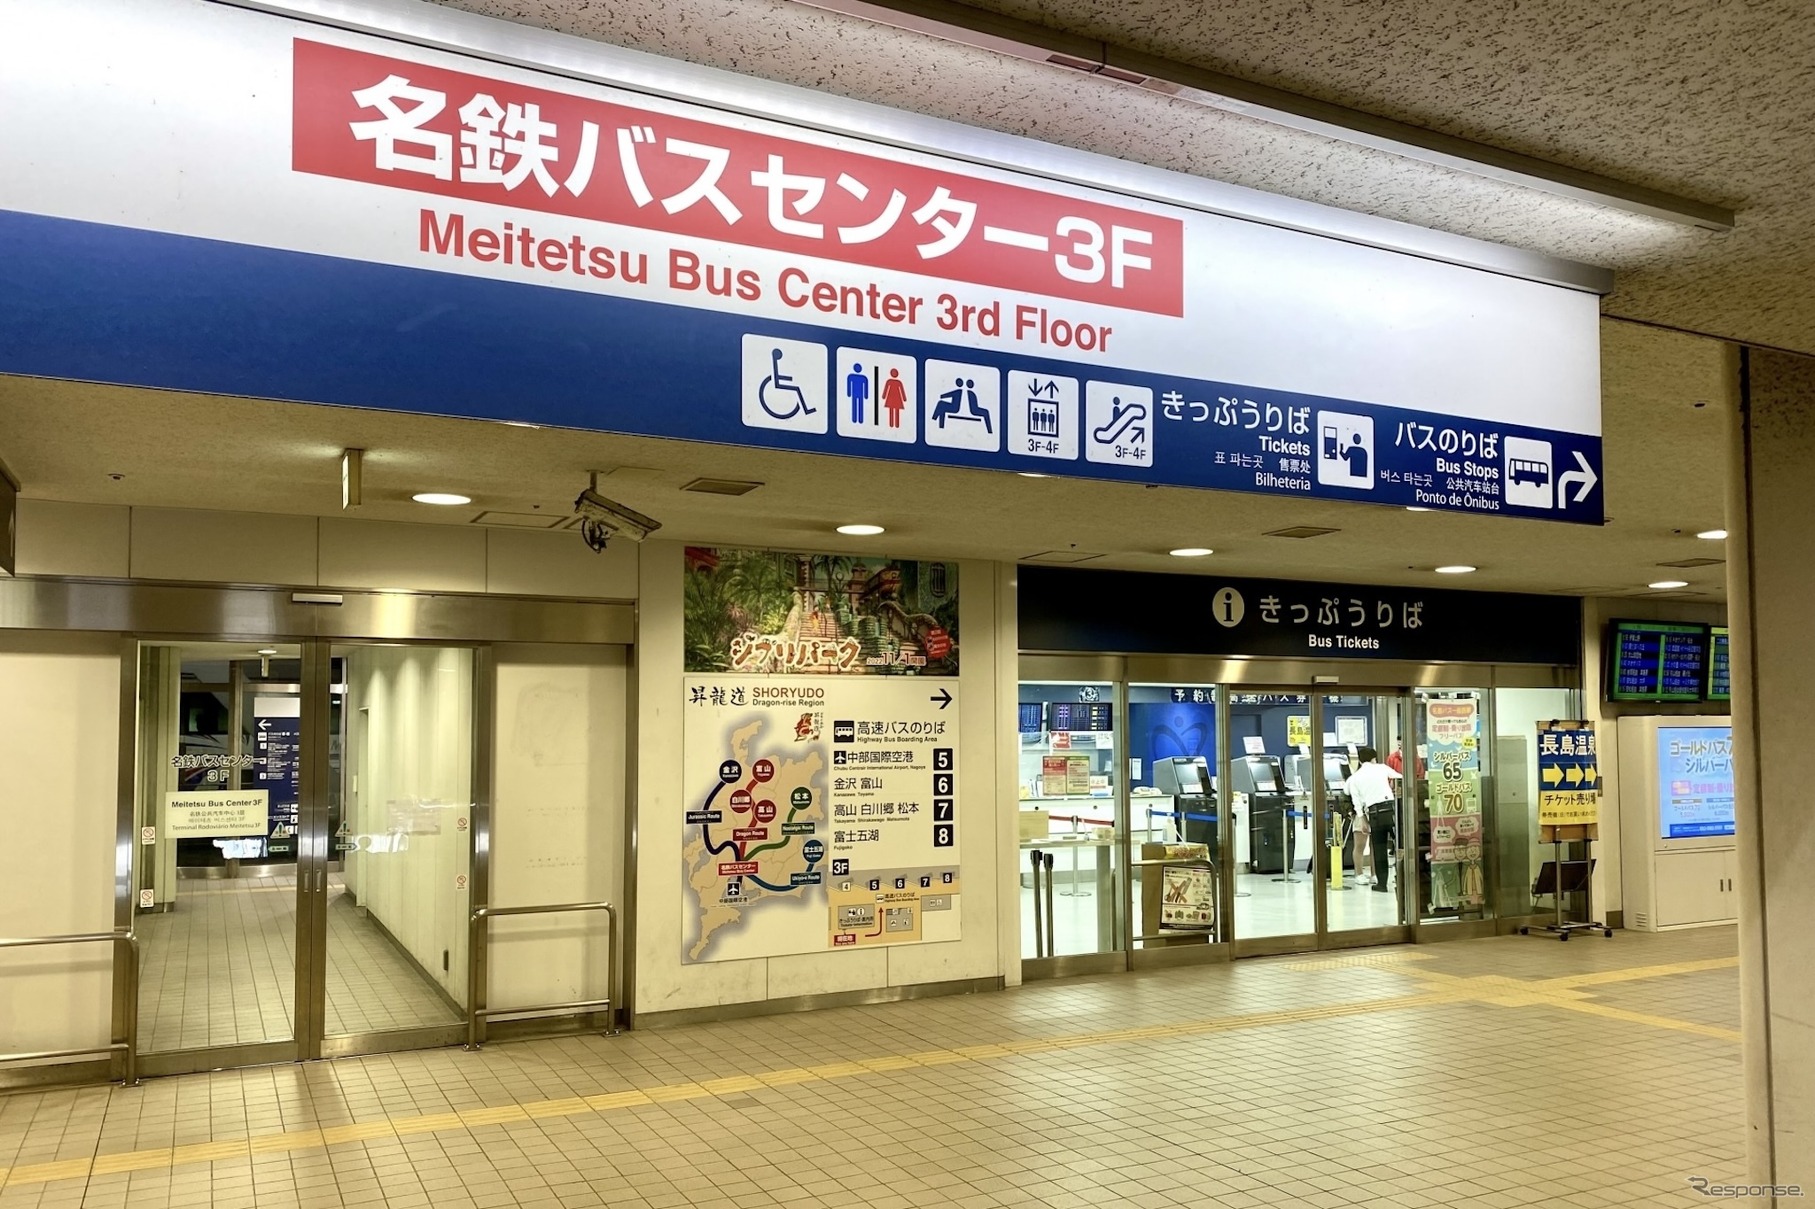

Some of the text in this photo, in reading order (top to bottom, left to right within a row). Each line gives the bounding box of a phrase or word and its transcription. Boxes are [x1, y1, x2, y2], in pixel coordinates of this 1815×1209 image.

[350, 75, 1153, 291] 名鉄バスセンター3F
[419, 208, 1113, 354] Meitetsu Bus Center 3rd Floor
[1161, 390, 1311, 436] きっぷうりば
[1027, 438, 1060, 454] 3F-4F
[1258, 435, 1311, 457] Tickets
[1394, 421, 1499, 459] バスのりば
[1115, 444, 1147, 460] 3F-4F
[1214, 452, 1264, 470] 표 파는곳
[1278, 457, 1312, 475] 售票处
[1436, 457, 1499, 480] Bus Stops
[1256, 472, 1311, 491] Bilheteria
[1380, 469, 1433, 489] 버스 타는곳
[1446, 477, 1500, 496] 公共汽车站台
[1416, 488, 1499, 510] Ponto de Ônibus
[1258, 595, 1425, 630] きっぷうりば
[1308, 634, 1380, 650] Bus Tickets
[731, 633, 862, 670] ジブリパーク
[688, 686, 749, 707] 昇龍道
[752, 687, 825, 699] SHORYUDO
[752, 699, 825, 708] Dragon-rise Region
[857, 721, 946, 735] 高速バスのりば
[857, 736, 883, 744] Highway
[897, 736, 923, 744] Boarding
[171, 754, 265, 769] 名鉄バスセンター
[847, 750, 914, 764] 中部国際空港
[937, 751, 949, 769] 5
[1443, 762, 1462, 780] 65
[834, 777, 883, 790] 金沢 富山
[938, 776, 949, 794] 6
[171, 801, 206, 809] Meitetsu
[208, 800, 224, 808] Bus
[226, 799, 252, 807] Center
[834, 801, 920, 817] 高山 白川郷 松本
[938, 802, 949, 819] 7
[1444, 794, 1463, 812] 70
[834, 829, 879, 843] 富士五湖
[938, 827, 949, 845] 8
[834, 862, 848, 875] 3F
